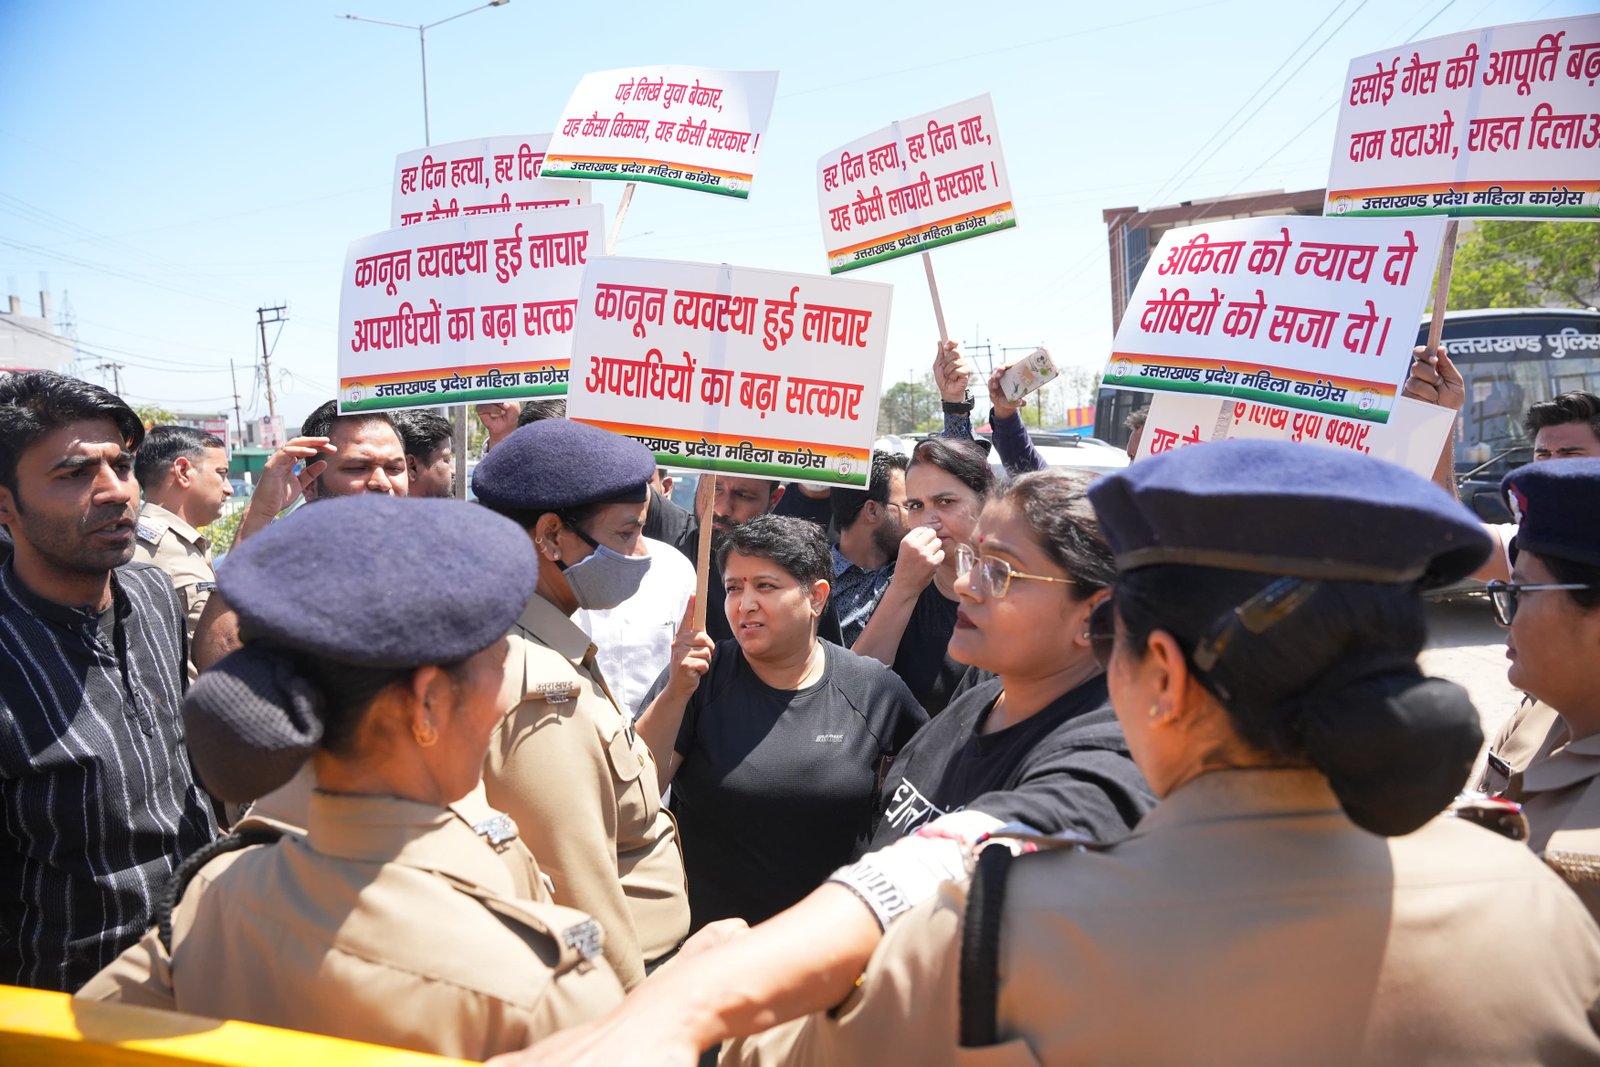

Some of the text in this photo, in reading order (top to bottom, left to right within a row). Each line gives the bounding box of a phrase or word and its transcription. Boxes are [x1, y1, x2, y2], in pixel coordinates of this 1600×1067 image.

[615, 76, 723, 112] पढ़े लिखे युवा बेकार,
[1350, 31, 1600, 106] रसोई गैस की आपूर्ति बढ़
[563, 118, 582, 137] यह
[581, 111, 610, 138] कैसा
[609, 112, 649, 144] विकास,
[655, 121, 677, 143] यह
[676, 116, 706, 147] कैसी
[706, 127, 751, 152] सरकार
[823, 115, 991, 192] हर दिन हत्या, हर दिन वार,
[1350, 130, 1386, 162] दाम
[1390, 110, 1459, 160] घटाओ,
[1467, 116, 1525, 152] राहत
[401, 166, 418, 195] हर
[421, 155, 447, 191] दिन
[451, 157, 489, 189] हत्या,
[494, 154, 514, 183] हर
[570, 161, 721, 186] उत्तराखण्ड प्रदेश महिला कांग्रेस
[829, 205, 850, 232] यह
[852, 186, 885, 226] कैसी
[886, 171, 933, 217] लाचारी
[934, 164, 986, 202] सरकार
[1362, 186, 1585, 210] उत्तराखण्ड प्रदेश महिला कांग्रेस
[355, 223, 588, 296] कानून व्यवस्था हुई लाचार
[854, 216, 986, 260] उत्तराखण्ड प्रदेश महिला कांग्रेस
[1157, 227, 1418, 286] अंकिता को न्याय दो
[351, 298, 578, 352] अपराधियों का बढ़ा सत्क
[595, 283, 872, 351] कानून व्यवस्था हुई लाचार
[1140, 288, 1225, 335] दोषियों
[1222, 290, 1267, 339] को
[1268, 304, 1340, 349] सजा
[375, 366, 569, 398] उत्तराखण्ड प्रदेश महिला कांग्रेस
[585, 348, 864, 420] अपराधियों का बढ़ा सत्कार
[1140, 363, 1348, 402] उत्तराखण्ड प्रदेश महिला कांग्रेस
[686, 439, 721, 459] प्रदेश
[725, 442, 774, 463] महिला
[778, 449, 827, 470] कांग्रेस
